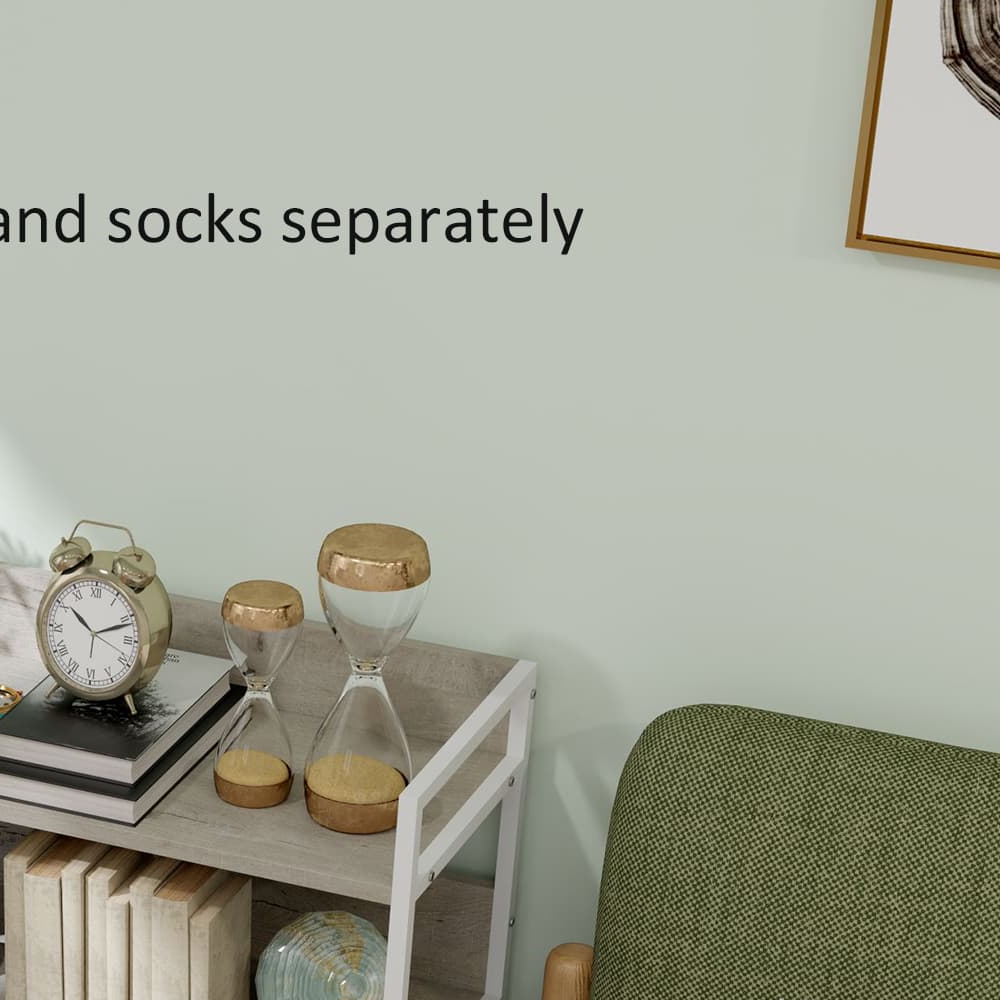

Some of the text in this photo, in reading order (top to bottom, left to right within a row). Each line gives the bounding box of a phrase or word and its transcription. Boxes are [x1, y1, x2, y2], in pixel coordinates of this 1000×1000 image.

[72, 590, 83, 602] XI
[90, 587, 102, 599] XII
[59, 602, 70, 614] X
[110, 598, 117, 607] I
[120, 615, 130, 623] II
[54, 622, 64, 633] IX
[123, 635, 133, 645] III
[57, 640, 69, 657] VIII
[68, 657, 80, 673] VII
[117, 656, 128, 666] IV
[86, 668, 96, 679] VI
[104, 666, 112, 677] V
